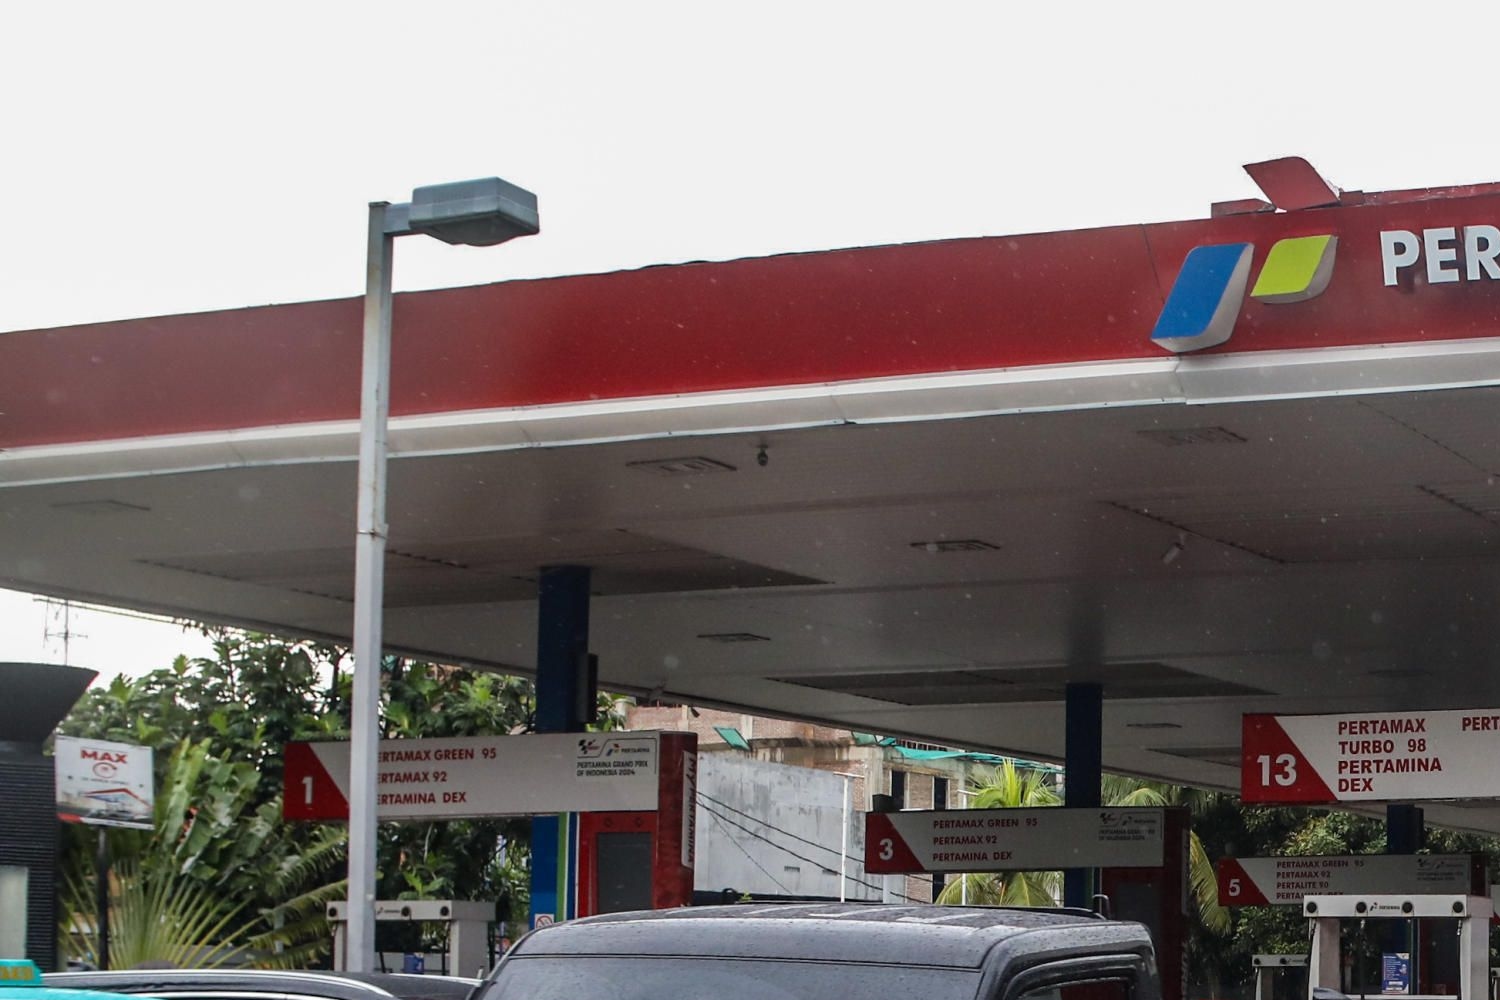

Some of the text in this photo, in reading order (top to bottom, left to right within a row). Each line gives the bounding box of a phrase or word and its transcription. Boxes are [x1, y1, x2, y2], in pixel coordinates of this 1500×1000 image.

[1338, 718, 1426, 735] PERTAMAX
[1339, 738, 1427, 755] TURBO 98
[81, 750, 128, 764] MAX
[377, 747, 497, 763] ERTAMAX GREEN 95
[1256, 753, 1297, 787] 13
[1338, 757, 1442, 775] PERTAMINA
[377, 770, 448, 784] ERTAMAX 92
[302, 776, 313, 804] 1
[1338, 777, 1374, 793] DEX
[377, 791, 467, 806] ERTAMINA DEX
[933, 817, 1038, 829] PERTAMAX GREEN 95
[933, 835, 997, 846] PERTAMAX 92
[880, 838, 893, 860] 3
[933, 851, 1013, 862] PERTAMINA DEX
[1276, 860, 1320, 869] PERTAMAX
[1322, 859, 1349, 868] GREEN
[1276, 871, 1319, 879] PERTAMAX
[1228, 879, 1241, 897] 5
[1276, 881, 1317, 890] PERTALITE
